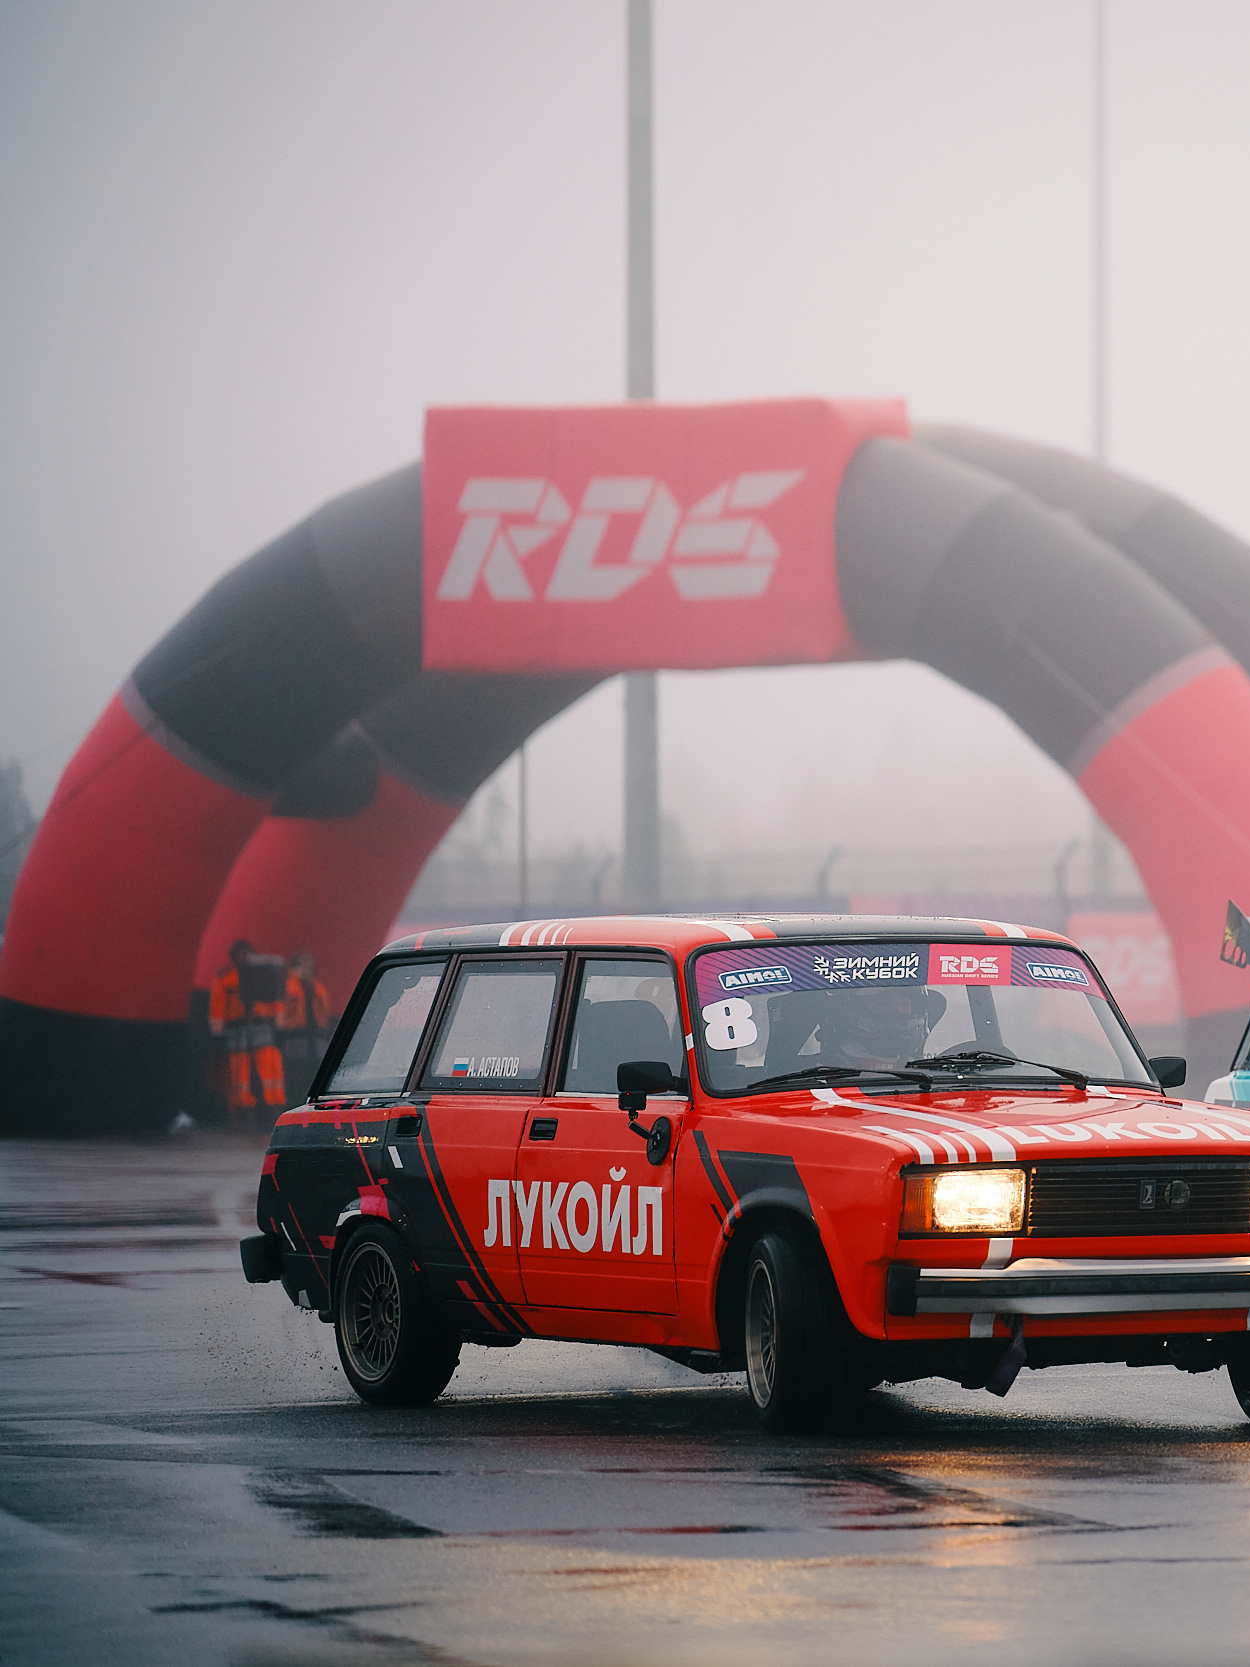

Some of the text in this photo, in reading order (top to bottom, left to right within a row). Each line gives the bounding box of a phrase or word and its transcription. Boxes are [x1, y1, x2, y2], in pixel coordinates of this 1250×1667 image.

[437, 469, 806, 601] RDS
[832, 952, 919, 969] ЗИМНИЙ
[939, 955, 999, 973] RDS
[725, 968, 787, 988] AIMOL
[852, 967, 919, 980] КУБОК
[1033, 966, 1086, 982] AIMOL
[702, 998, 758, 1050] 8
[478, 1056, 520, 1077] АСТАПОВ
[483, 1166, 663, 1256] ЛУКОЙЛ
